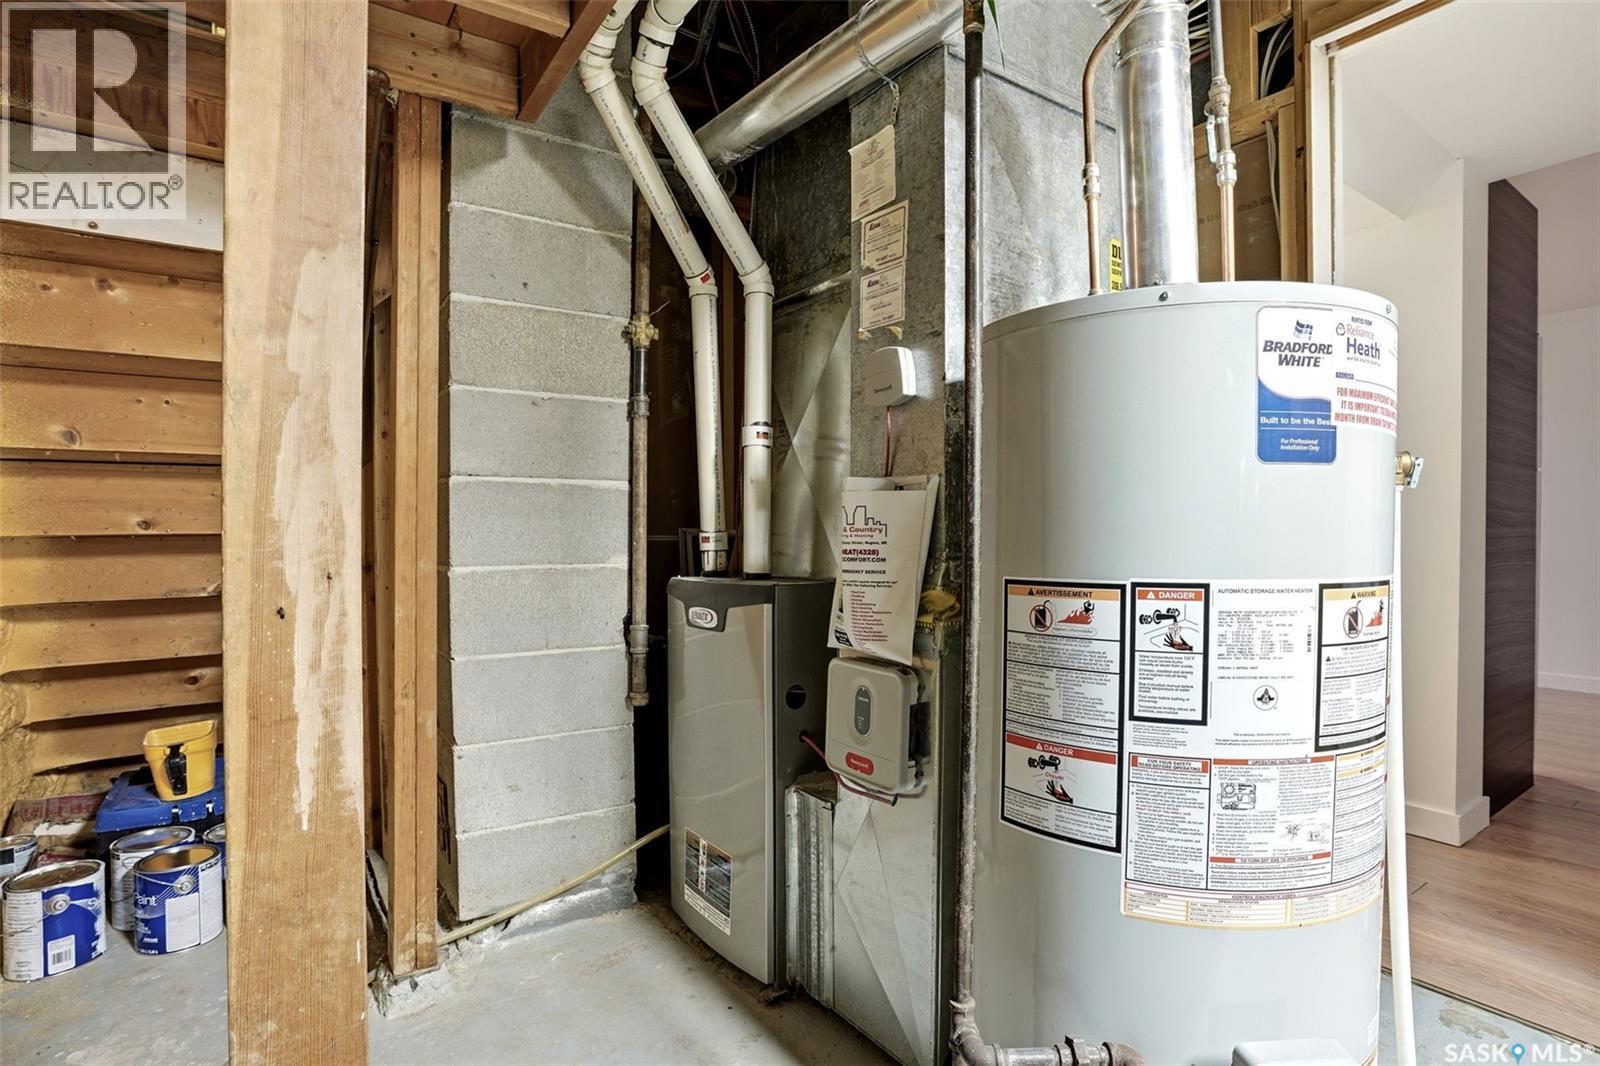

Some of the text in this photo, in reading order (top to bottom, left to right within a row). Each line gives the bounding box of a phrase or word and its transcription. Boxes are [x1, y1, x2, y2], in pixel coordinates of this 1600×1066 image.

[1263, 340, 1332, 355] BRADFORD
[1346, 337, 1380, 360] Heath
[1278, 354, 1321, 367] WHITE
[1260, 416, 1278, 424] Built
[1303, 417, 1315, 425] the
[1035, 588, 1093, 598] AVERTISSEMENT
[1159, 591, 1195, 600] DANGER
[1044, 744, 1074, 756] DANGER
